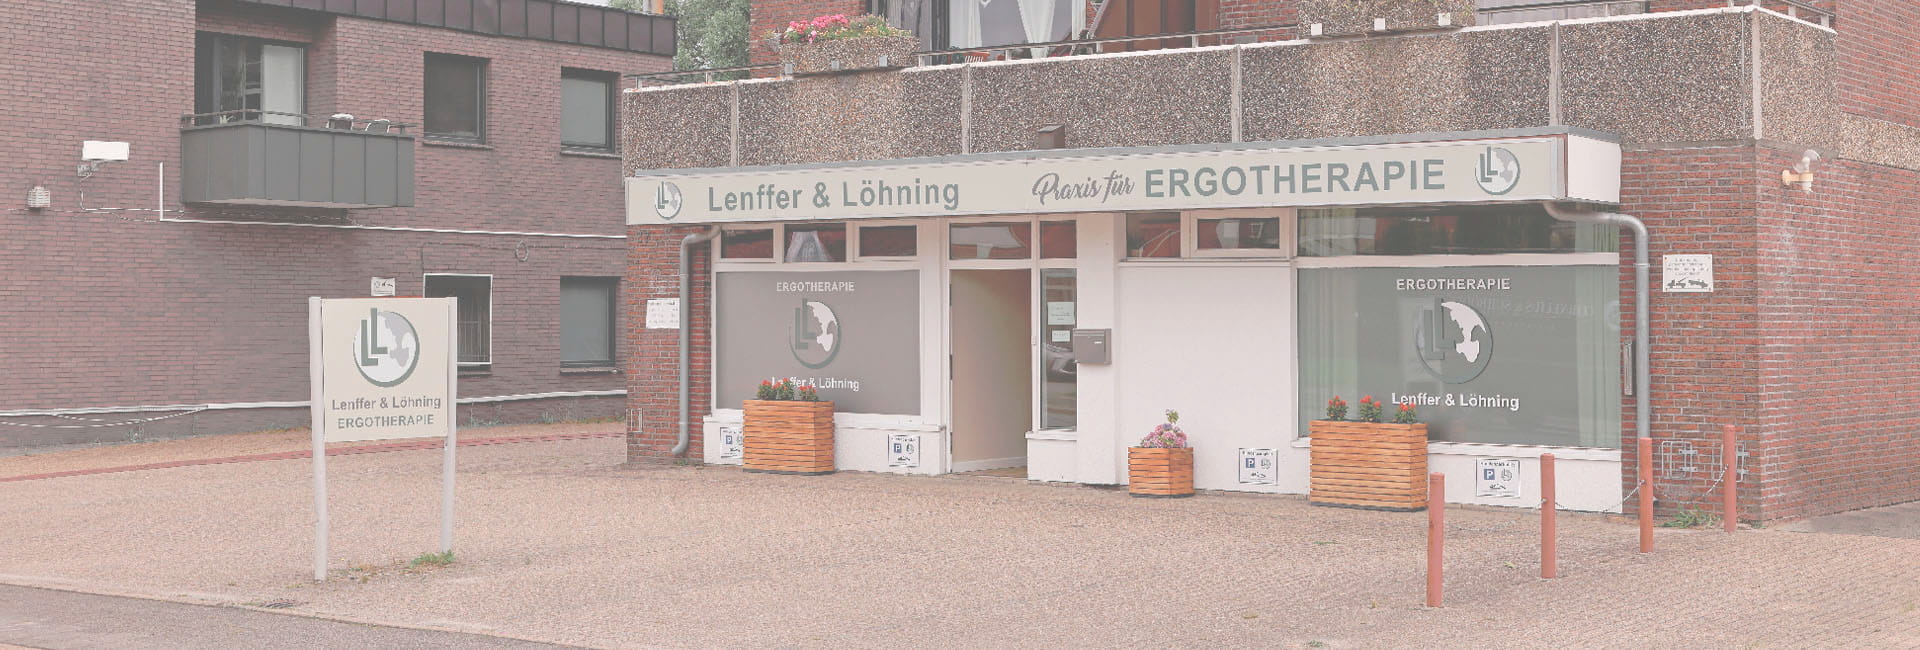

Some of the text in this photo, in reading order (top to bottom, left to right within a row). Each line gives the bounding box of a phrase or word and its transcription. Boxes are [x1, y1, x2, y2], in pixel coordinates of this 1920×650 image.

[1032, 159, 1445, 206] Praxis für ERGOTHERAPIE
[708, 178, 959, 212] Lenffer & Löhning
[776, 281, 855, 292] ERGOTHERAPIE
[1396, 278, 1511, 290] ERGOTHERAPIE
[809, 377, 817, 387] &
[818, 377, 860, 392] Löhning
[332, 396, 441, 410] Lenffer & Löhning
[1391, 392, 1520, 411] Lenffer & Löhning
[337, 414, 434, 429] ERGOTHERAPIE
